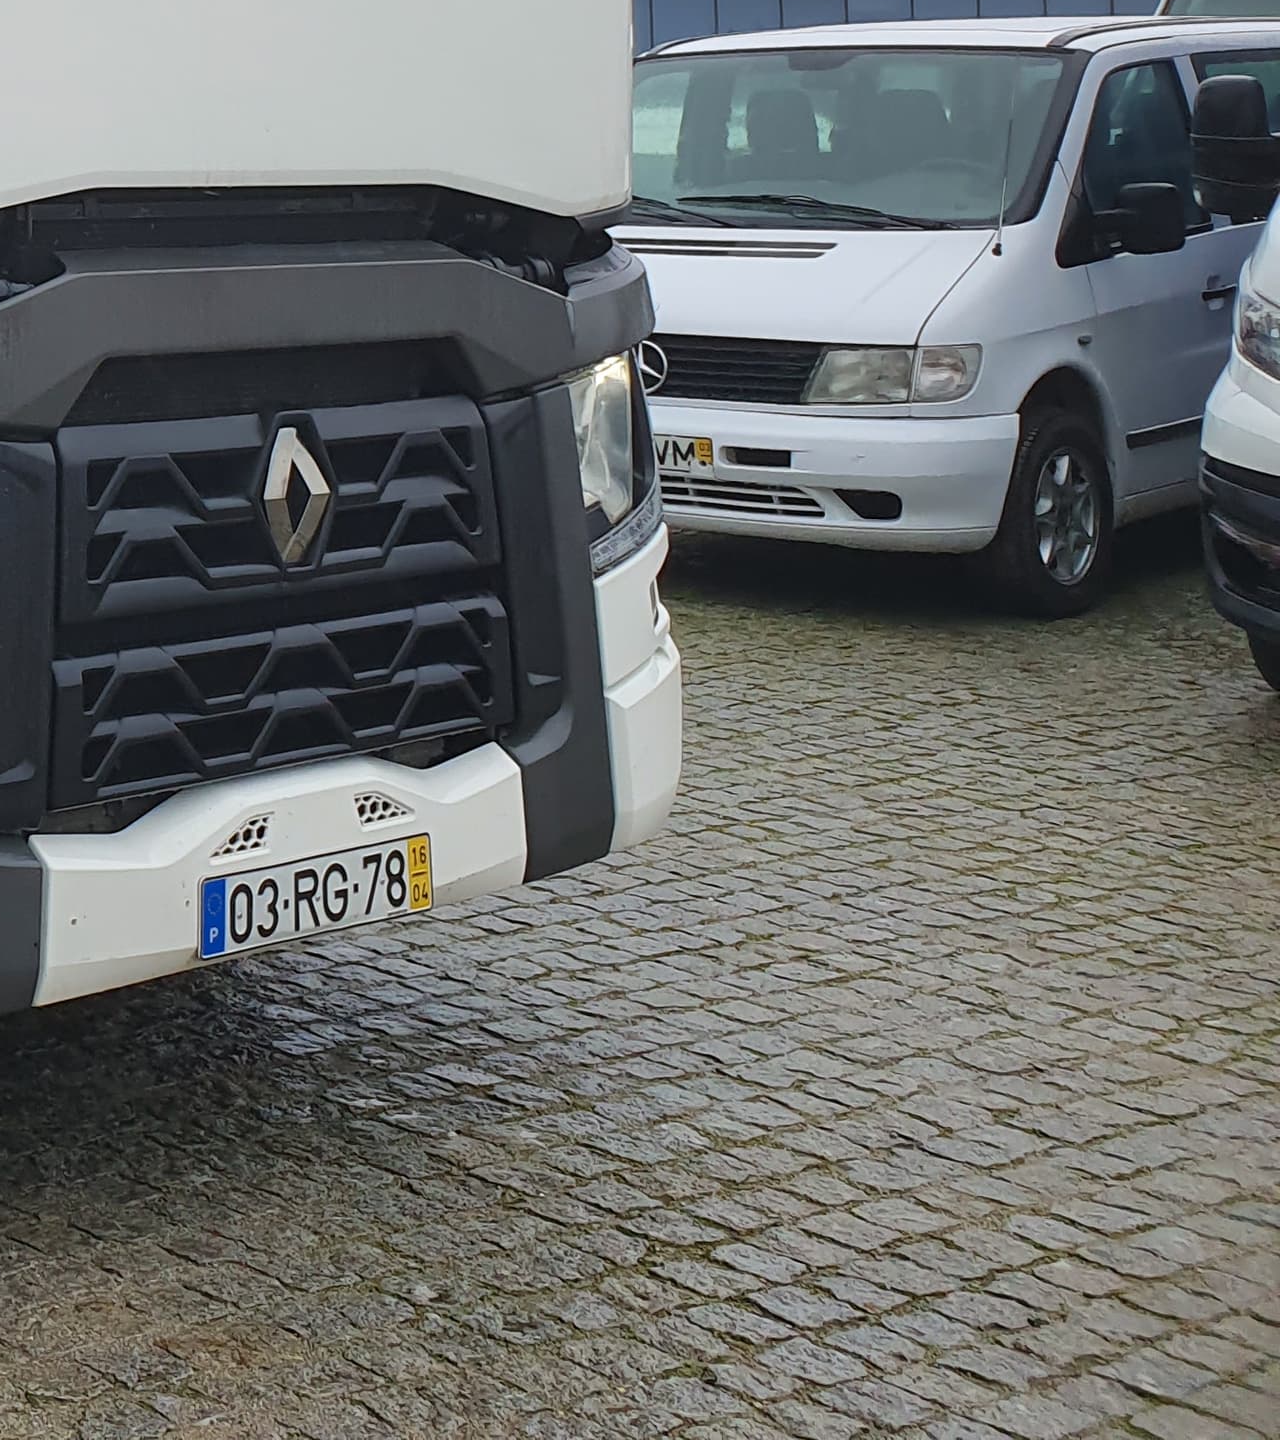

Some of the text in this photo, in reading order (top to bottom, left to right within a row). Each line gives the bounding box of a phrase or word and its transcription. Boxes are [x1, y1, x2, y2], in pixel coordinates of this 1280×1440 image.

[411, 845, 427, 867] 16
[209, 849, 407, 944] P 03-RG-78
[412, 881, 428, 903] 04
